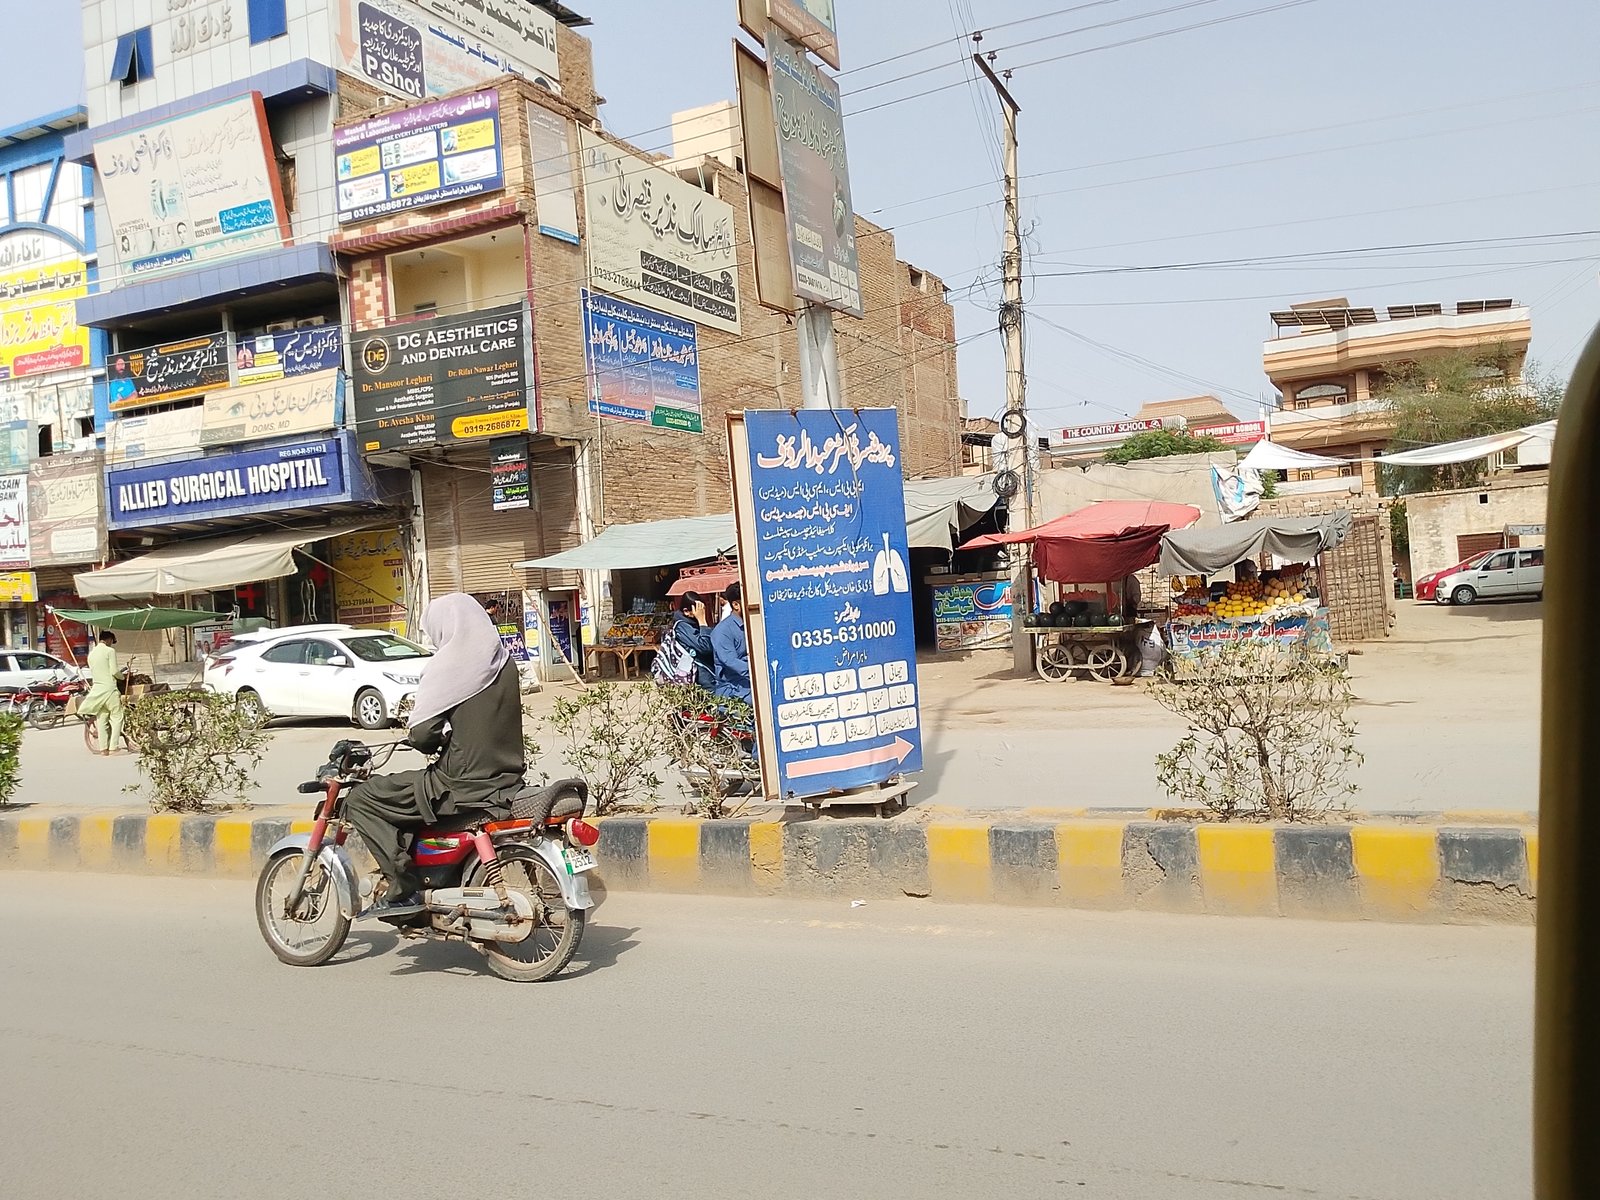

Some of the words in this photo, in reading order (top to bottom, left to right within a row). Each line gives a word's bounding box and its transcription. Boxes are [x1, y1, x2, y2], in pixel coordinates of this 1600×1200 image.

[366, 53, 422, 98] P.Shot
[375, 134, 394, 144] WHERE
[394, 130, 411, 140] EVERY
[411, 127, 423, 136] LIFE
[423, 121, 448, 132] MATTERS
[397, 333, 421, 350] DG
[425, 318, 518, 346] AESTHETICS
[401, 352, 427, 366] AND
[429, 343, 479, 361] DENTAL
[480, 337, 517, 353] CARE
[447, 369, 458, 378] Dr.
[494, 360, 518, 372] Leghari
[362, 383, 374, 392] Dr.
[374, 379, 405, 390] Mansoor
[405, 373, 433, 386] Leghari
[251, 422, 276, 434] DOMS,
[279, 419, 290, 430] MD
[378, 419, 390, 428] Dr.
[390, 416, 415, 427] Ayesha
[415, 413, 435, 423] Khan
[464, 419, 521, 434] 0319-2686872
[1067, 428, 1080, 438] THE
[1080, 424, 1116, 437] COUNTRY
[1117, 420, 1149, 432] SCHOOL
[1205, 424, 1235, 437] COUNTRY
[1235, 422, 1261, 433] SCHOOL
[828, 422, 860, 475] ڈاکٹر
[854, 430, 896, 472] پروفیسر
[119, 480, 167, 512] ALLIED
[170, 468, 246, 505] SURGICAL
[247, 456, 328, 495] HOSPITAL
[791, 620, 896, 649] 0335-6310000
[572, 855, 593, 868] 2512
